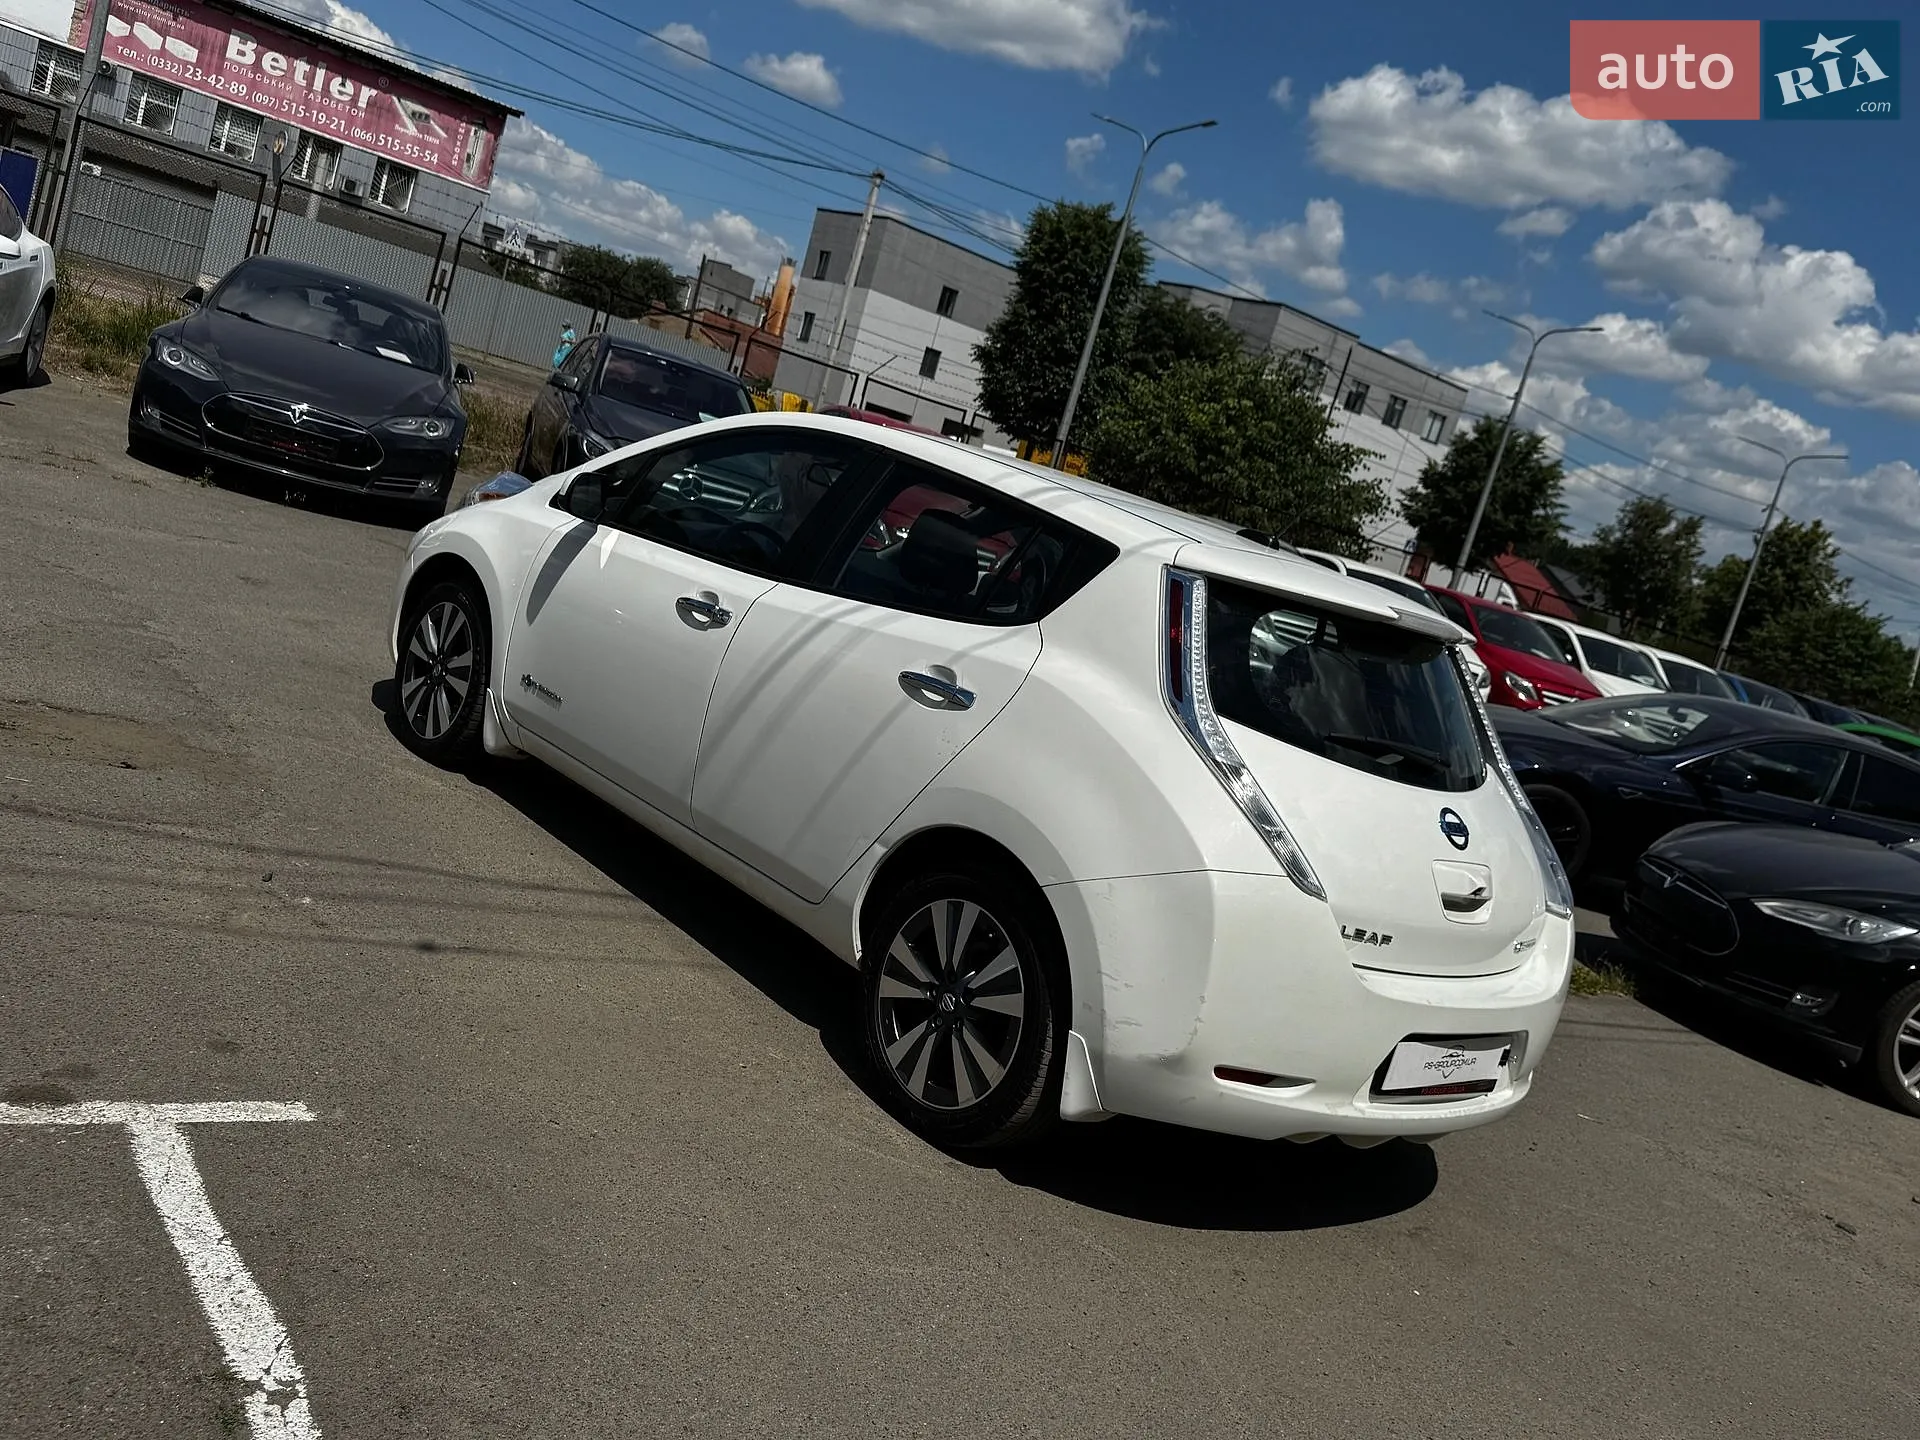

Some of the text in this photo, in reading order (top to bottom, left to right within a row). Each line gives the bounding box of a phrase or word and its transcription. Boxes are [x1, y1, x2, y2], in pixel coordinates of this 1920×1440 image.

[223, 61, 366, 119] ПОЛЬСЬКИЙ ГАЗОБЕТОН
[225, 28, 378, 109] Betler
[116, 45, 439, 165] тел.: (0332) 23-42-89, (097) 515-19-21, (066) 515-55-54
[1340, 925, 1393, 947] LEAF
